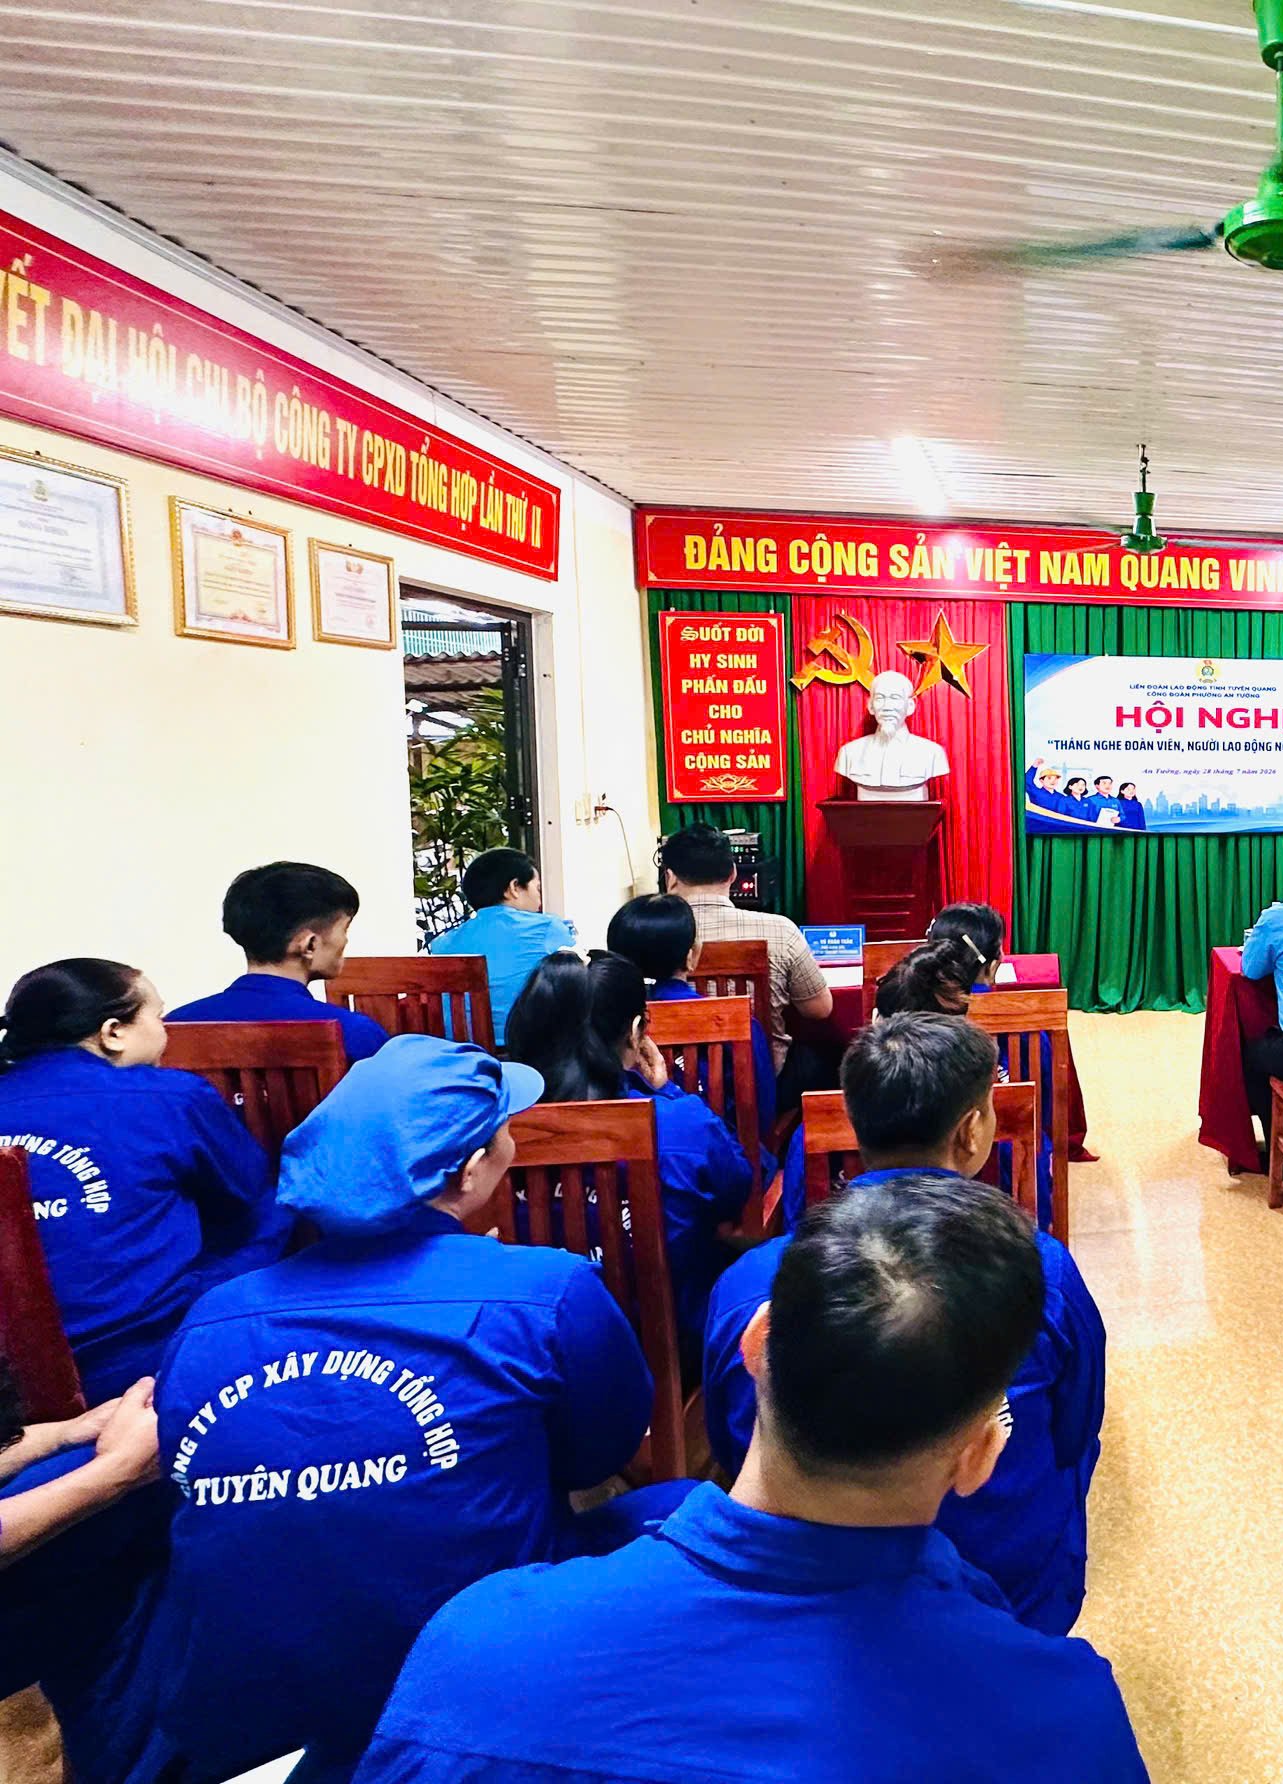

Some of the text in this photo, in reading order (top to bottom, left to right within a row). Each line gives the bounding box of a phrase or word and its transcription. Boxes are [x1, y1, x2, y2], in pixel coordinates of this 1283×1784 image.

[128, 323, 177, 424] HỘI
[236, 368, 268, 460] BỘ
[274, 385, 331, 470] CÔNG
[336, 417, 358, 479] TY
[361, 429, 407, 497] CPXD
[409, 436, 448, 513] TỔNG
[450, 470, 478, 531] HỢP
[479, 470, 503, 534] LẦN
[505, 491, 528, 542] THỨ
[684, 523, 778, 573] ĐẢNG
[789, 533, 879, 583] CỘNG
[889, 533, 955, 580] SẢN
[965, 541, 1031, 590] VIỆT
[1039, 550, 1110, 586] NAM
[1120, 554, 1220, 591] QUANG
[680, 622, 764, 642] SUỐT ĐỜI
[689, 653, 757, 669] HY SINH
[681, 674, 767, 694] PHẤN ĐẤU
[708, 704, 743, 719] CHO
[1116, 700, 1184, 733] HỘI
[681, 723, 772, 744] CHỦ NGHĨA
[1093, 740, 1122, 750] NGHE
[1124, 738, 1154, 751] ĐOÀN
[1157, 738, 1185, 752] VIÊN,
[1187, 738, 1219, 751] NGƯỜI
[1222, 741, 1241, 751] LAO
[1244, 739, 1272, 753] ĐỘNG
[684, 749, 771, 772] CỘNG SẢN
[51, 1144, 101, 1181] TỔNG
[80, 1179, 111, 1213] HỢP
[188, 1401, 217, 1435] TY
[218, 1374, 254, 1409] CP
[263, 1351, 318, 1388] XÂY
[321, 1349, 395, 1385] DỰNG
[389, 1368, 445, 1427] TỔNG
[422, 1422, 460, 1470] HỢP
[193, 1454, 408, 1506] TUYÊN QUANG
